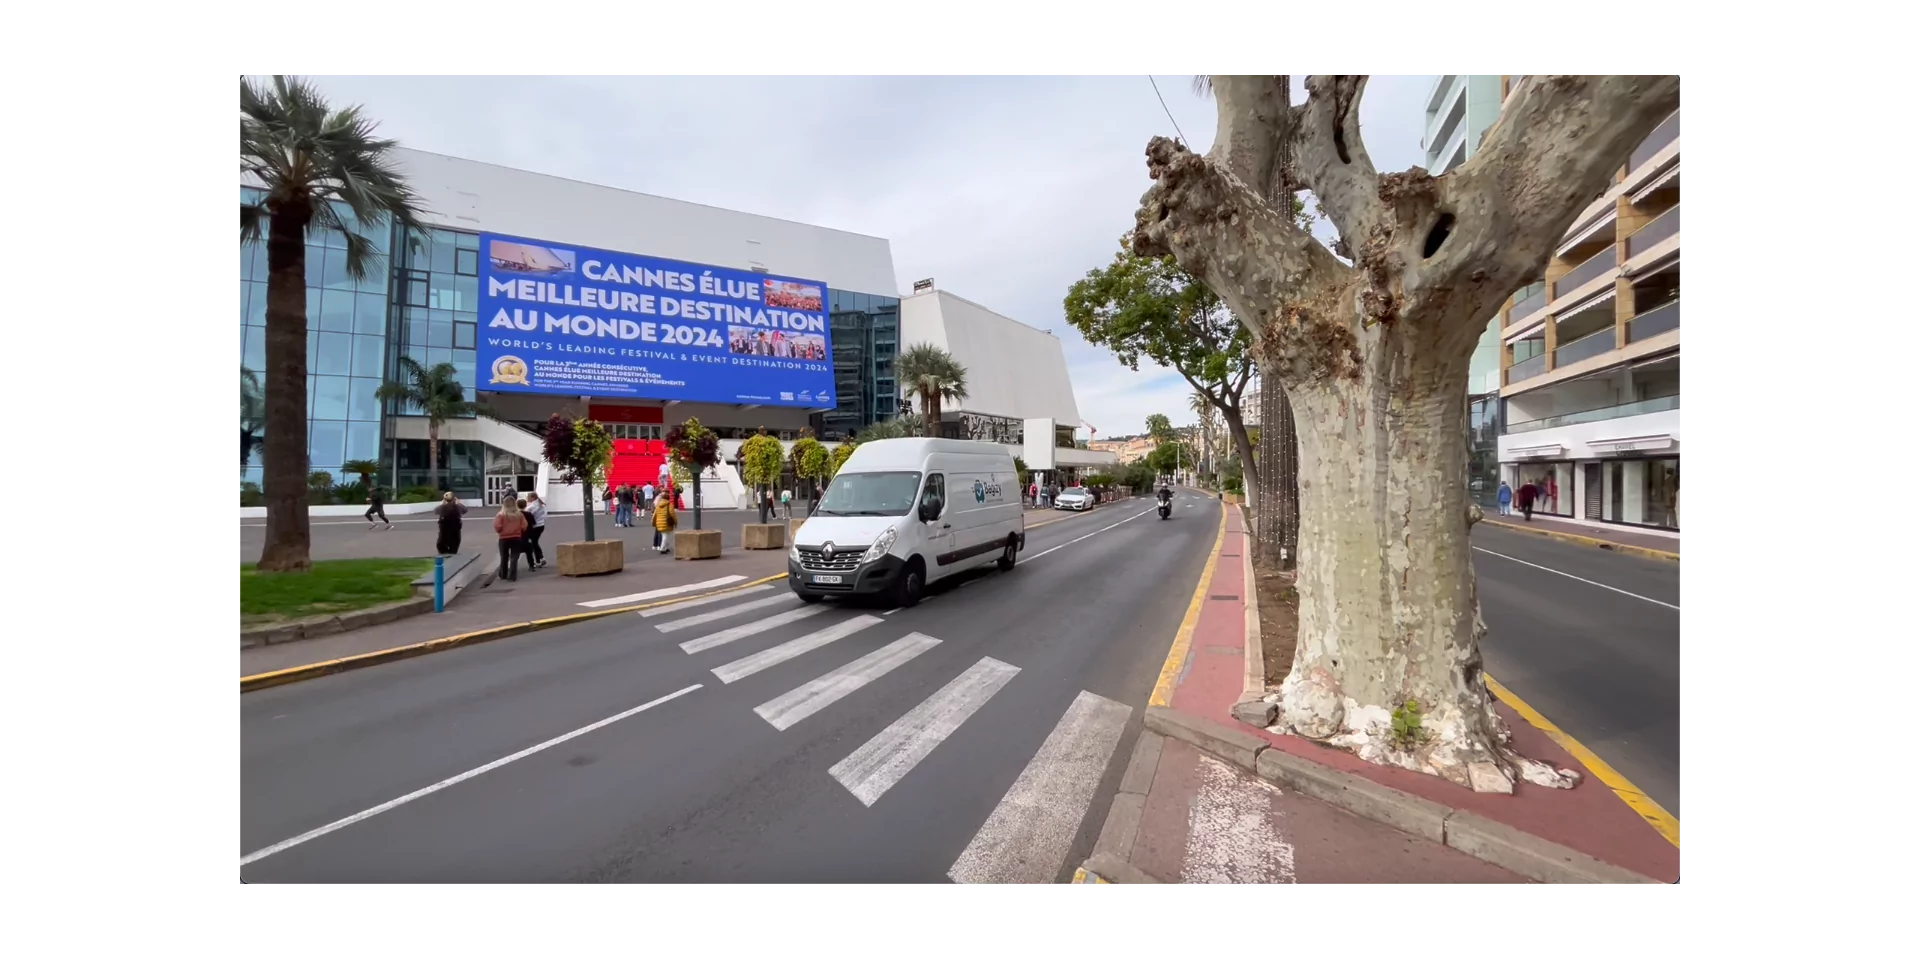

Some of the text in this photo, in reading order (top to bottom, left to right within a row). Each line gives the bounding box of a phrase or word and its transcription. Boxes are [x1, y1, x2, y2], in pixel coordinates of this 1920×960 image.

[582, 259, 761, 301] CANNES ÉLUE
[488, 276, 825, 332] MEILLEURE DESTINATION
[488, 307, 724, 348] AU MONDE 2024
[488, 337, 828, 372] WORLD'S LEADING FESTIVAL & EVENT DESTINATION 2024
[601, 364, 648, 373] CONSÉCUTIVE,
[581, 368, 618, 376] MEILLEURE
[618, 370, 661, 379] DESTINATION
[605, 375, 639, 384] FESTIVALS
[644, 377, 686, 387] ÉVÉNEMENTS
